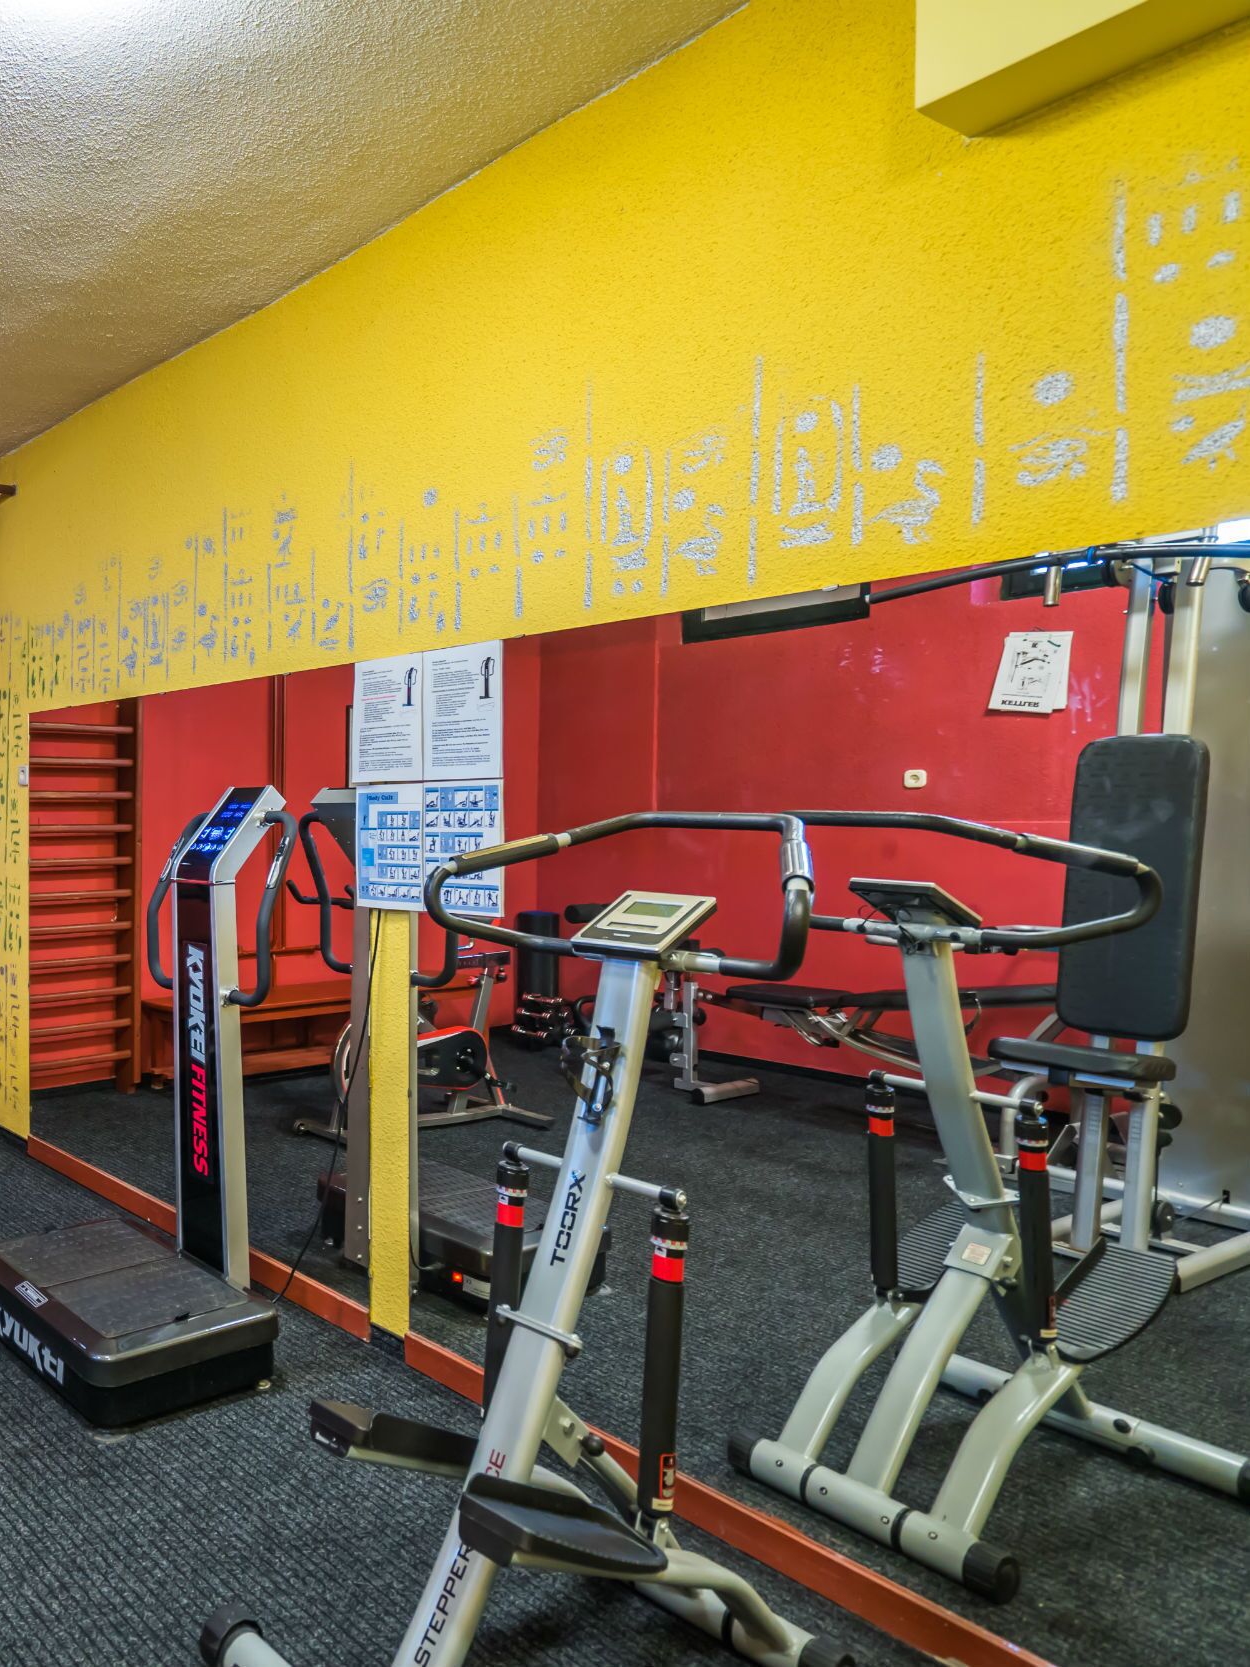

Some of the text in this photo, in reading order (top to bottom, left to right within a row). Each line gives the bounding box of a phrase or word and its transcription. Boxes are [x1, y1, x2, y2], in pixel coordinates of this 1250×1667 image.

[186, 943, 208, 1177] KYOKEI FITNESS
[550, 1170, 586, 1266] TOORX
[414, 1544, 470, 1667] STEPPER
